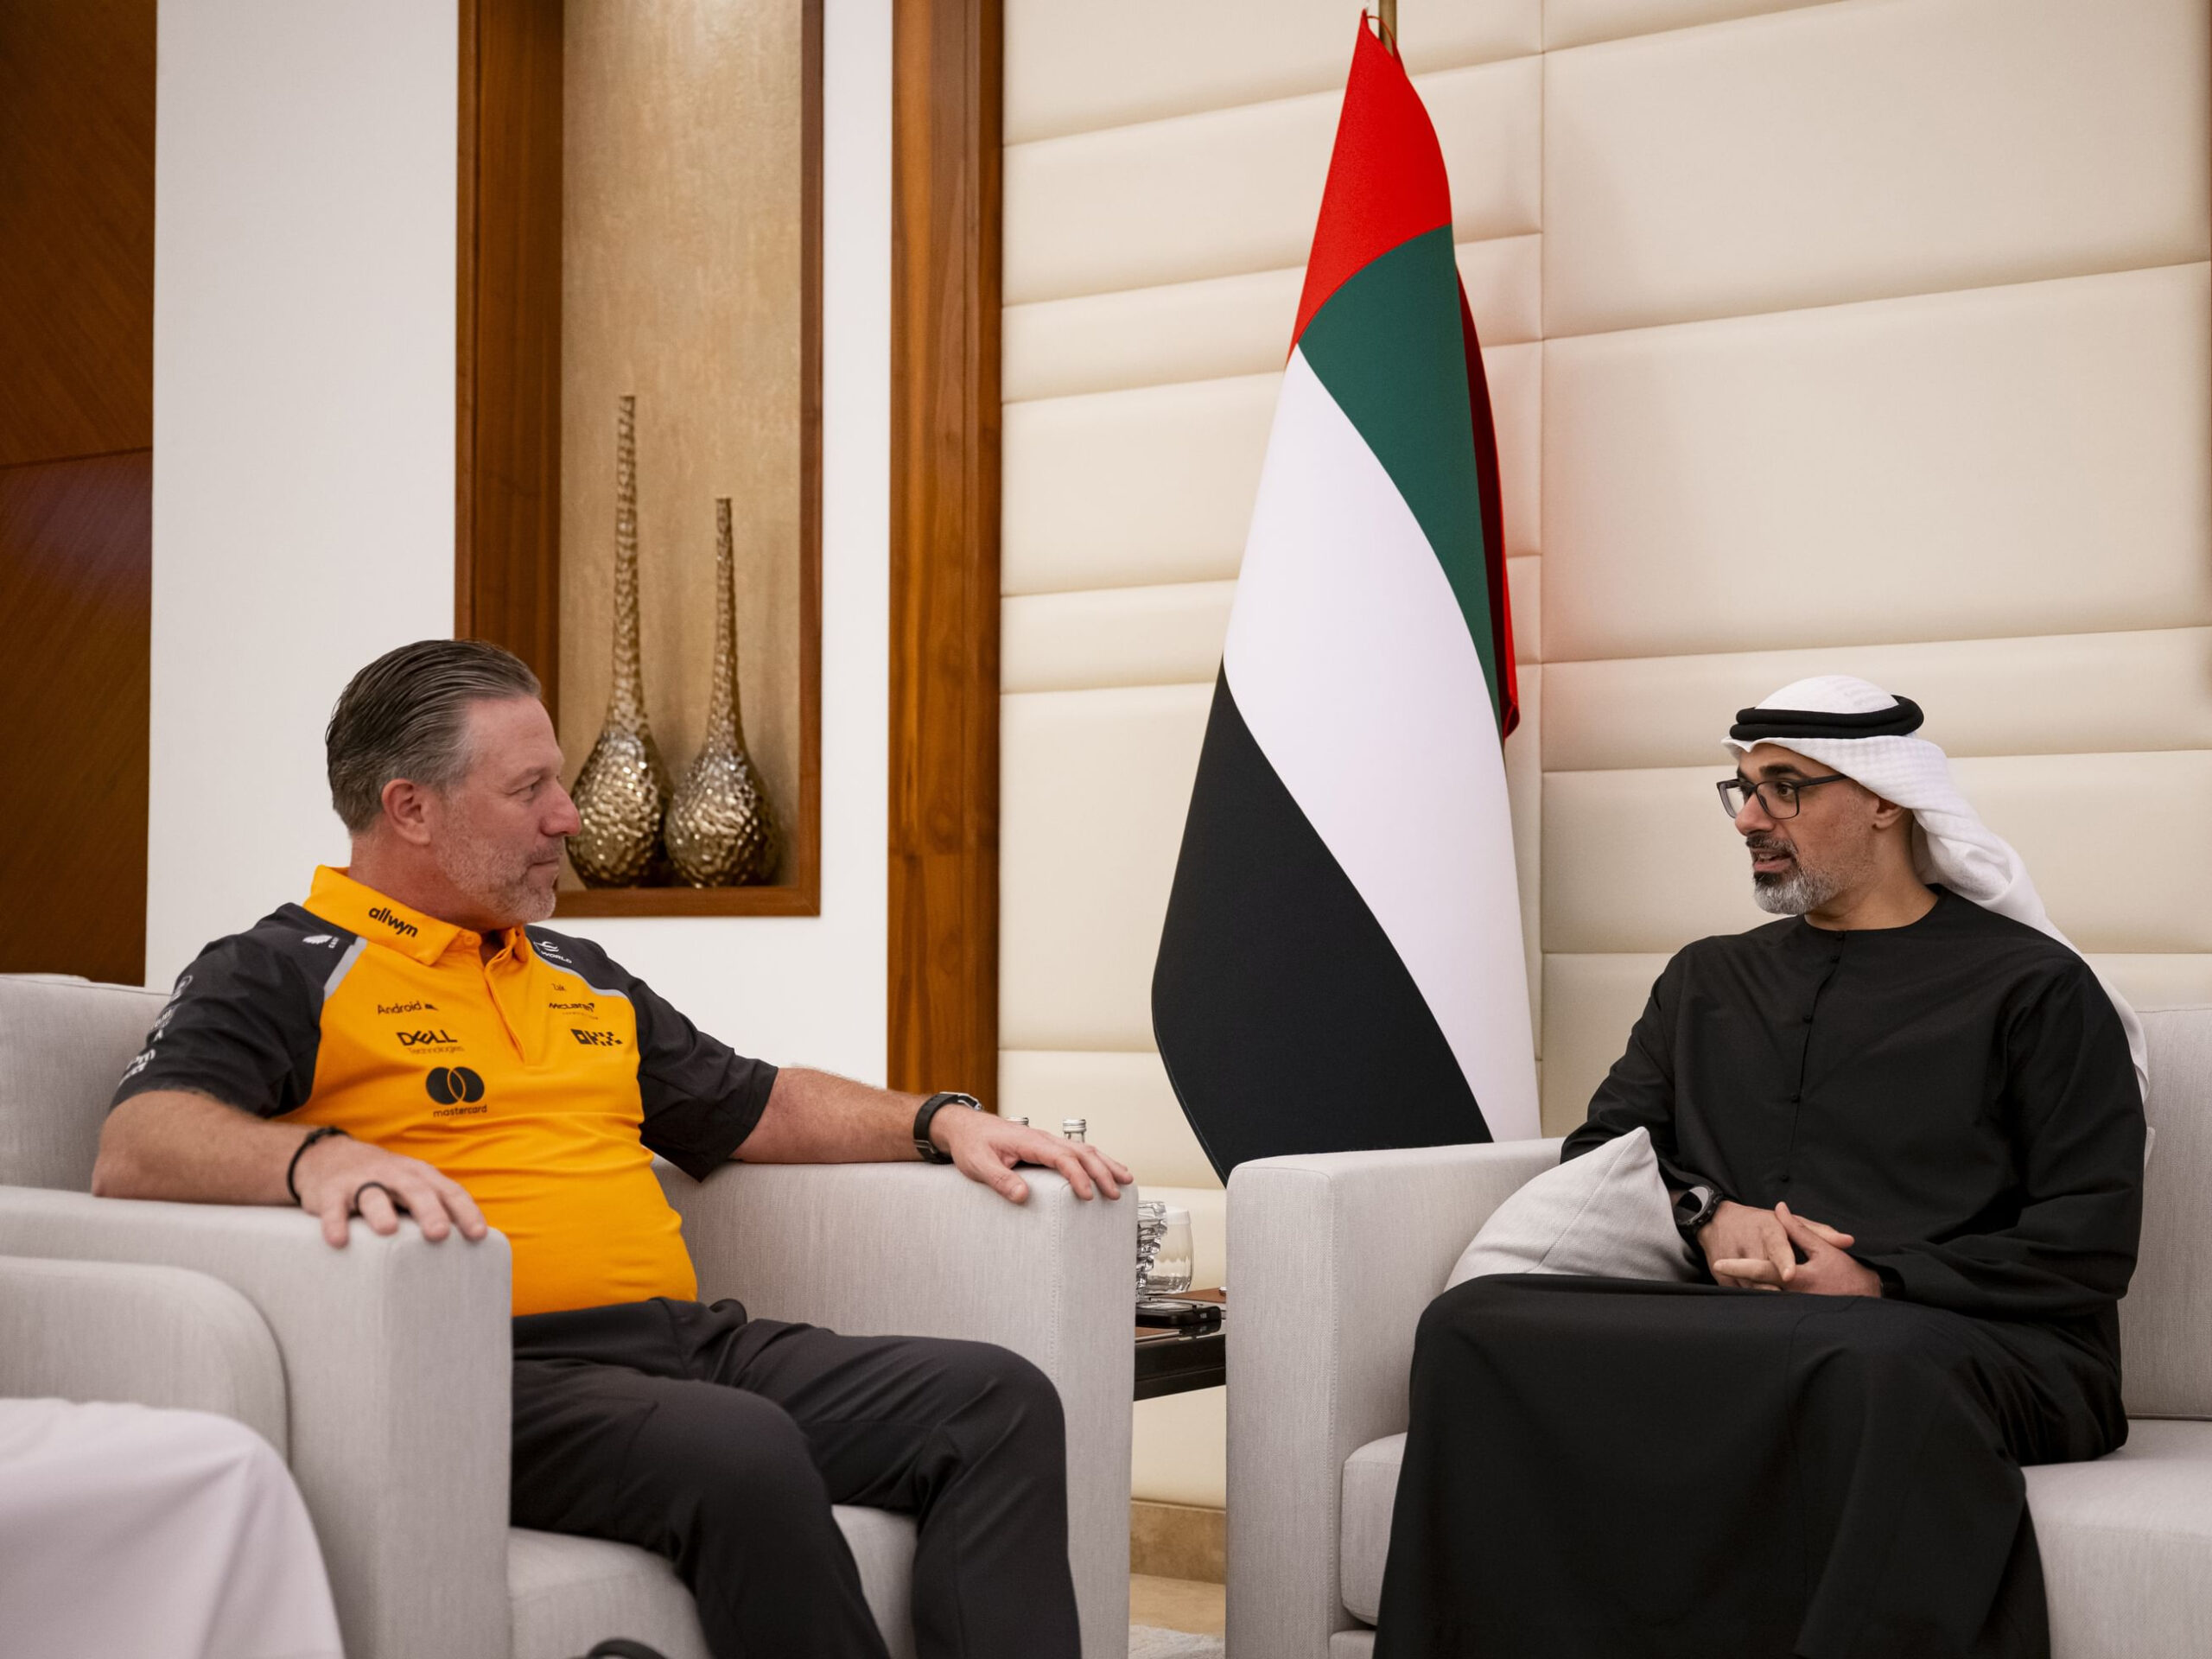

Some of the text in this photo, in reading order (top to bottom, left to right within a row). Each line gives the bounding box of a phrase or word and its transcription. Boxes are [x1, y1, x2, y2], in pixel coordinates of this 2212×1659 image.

[368, 907, 418, 938] allwyn
[540, 950, 572, 963] WORLD
[378, 1001, 422, 1014] Android
[396, 1029, 458, 1046] DELL
[433, 1104, 487, 1117] mastercard
